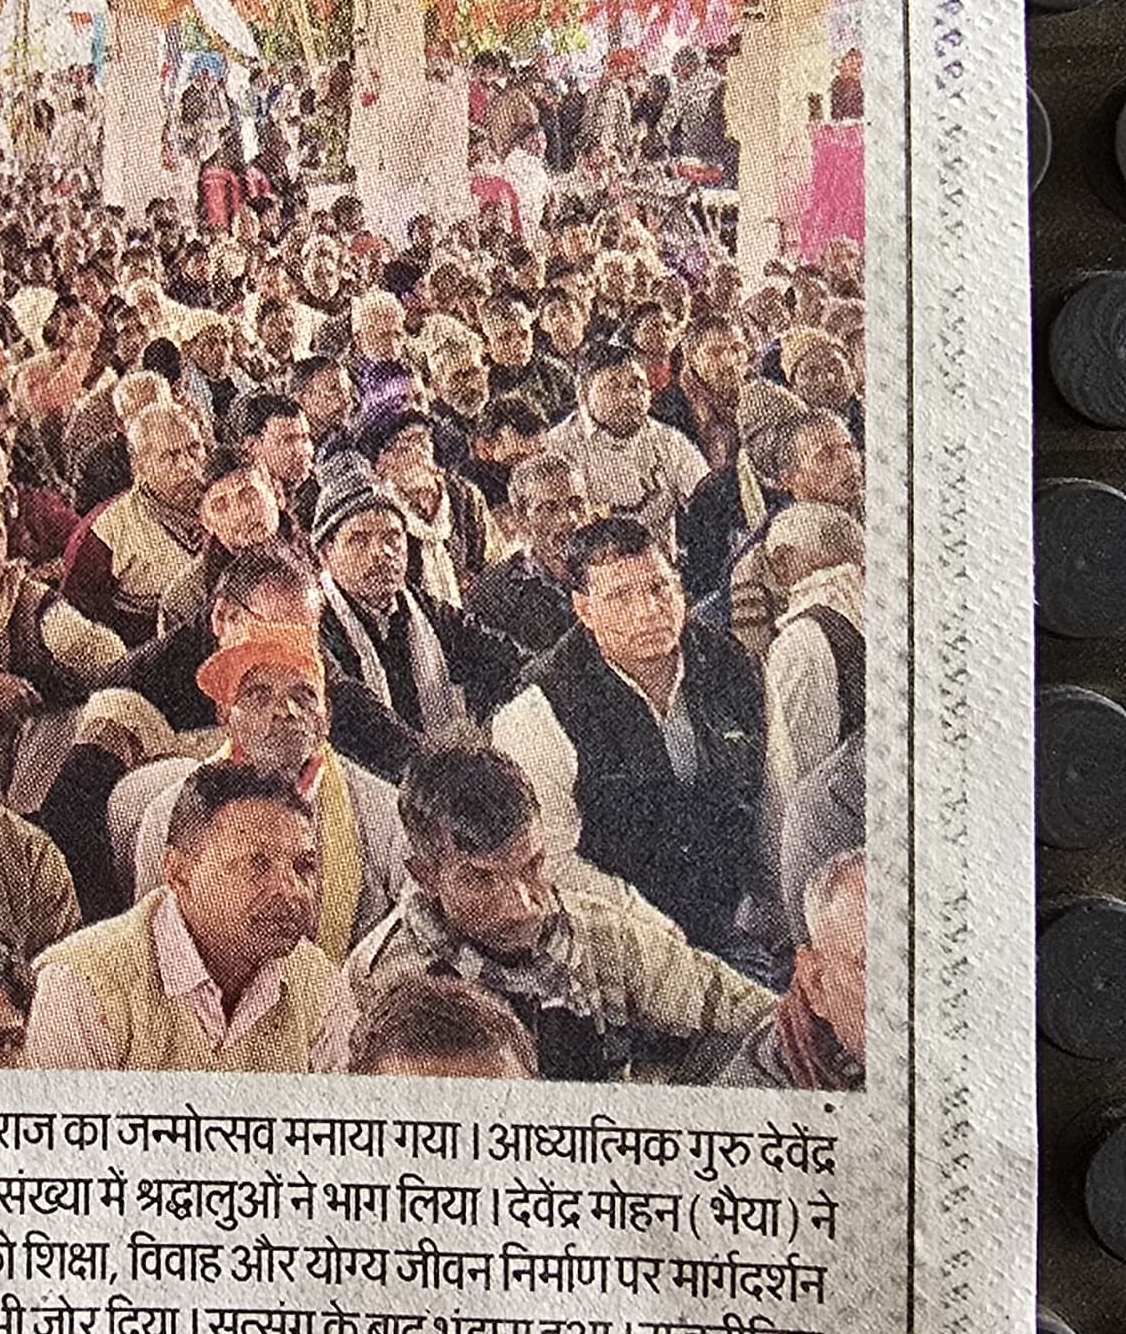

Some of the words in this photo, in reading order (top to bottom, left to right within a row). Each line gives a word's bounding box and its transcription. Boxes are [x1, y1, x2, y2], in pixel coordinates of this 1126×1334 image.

[62, 1114, 111, 1151] का
[116, 1103, 277, 1154] जन्मोत्सव
[282, 1118, 388, 1157] मनाया
[488, 1114, 683, 1166] आध्यात्मिक
[688, 1130, 754, 1181] गुरु
[758, 1121, 838, 1176] देवेंद्र
